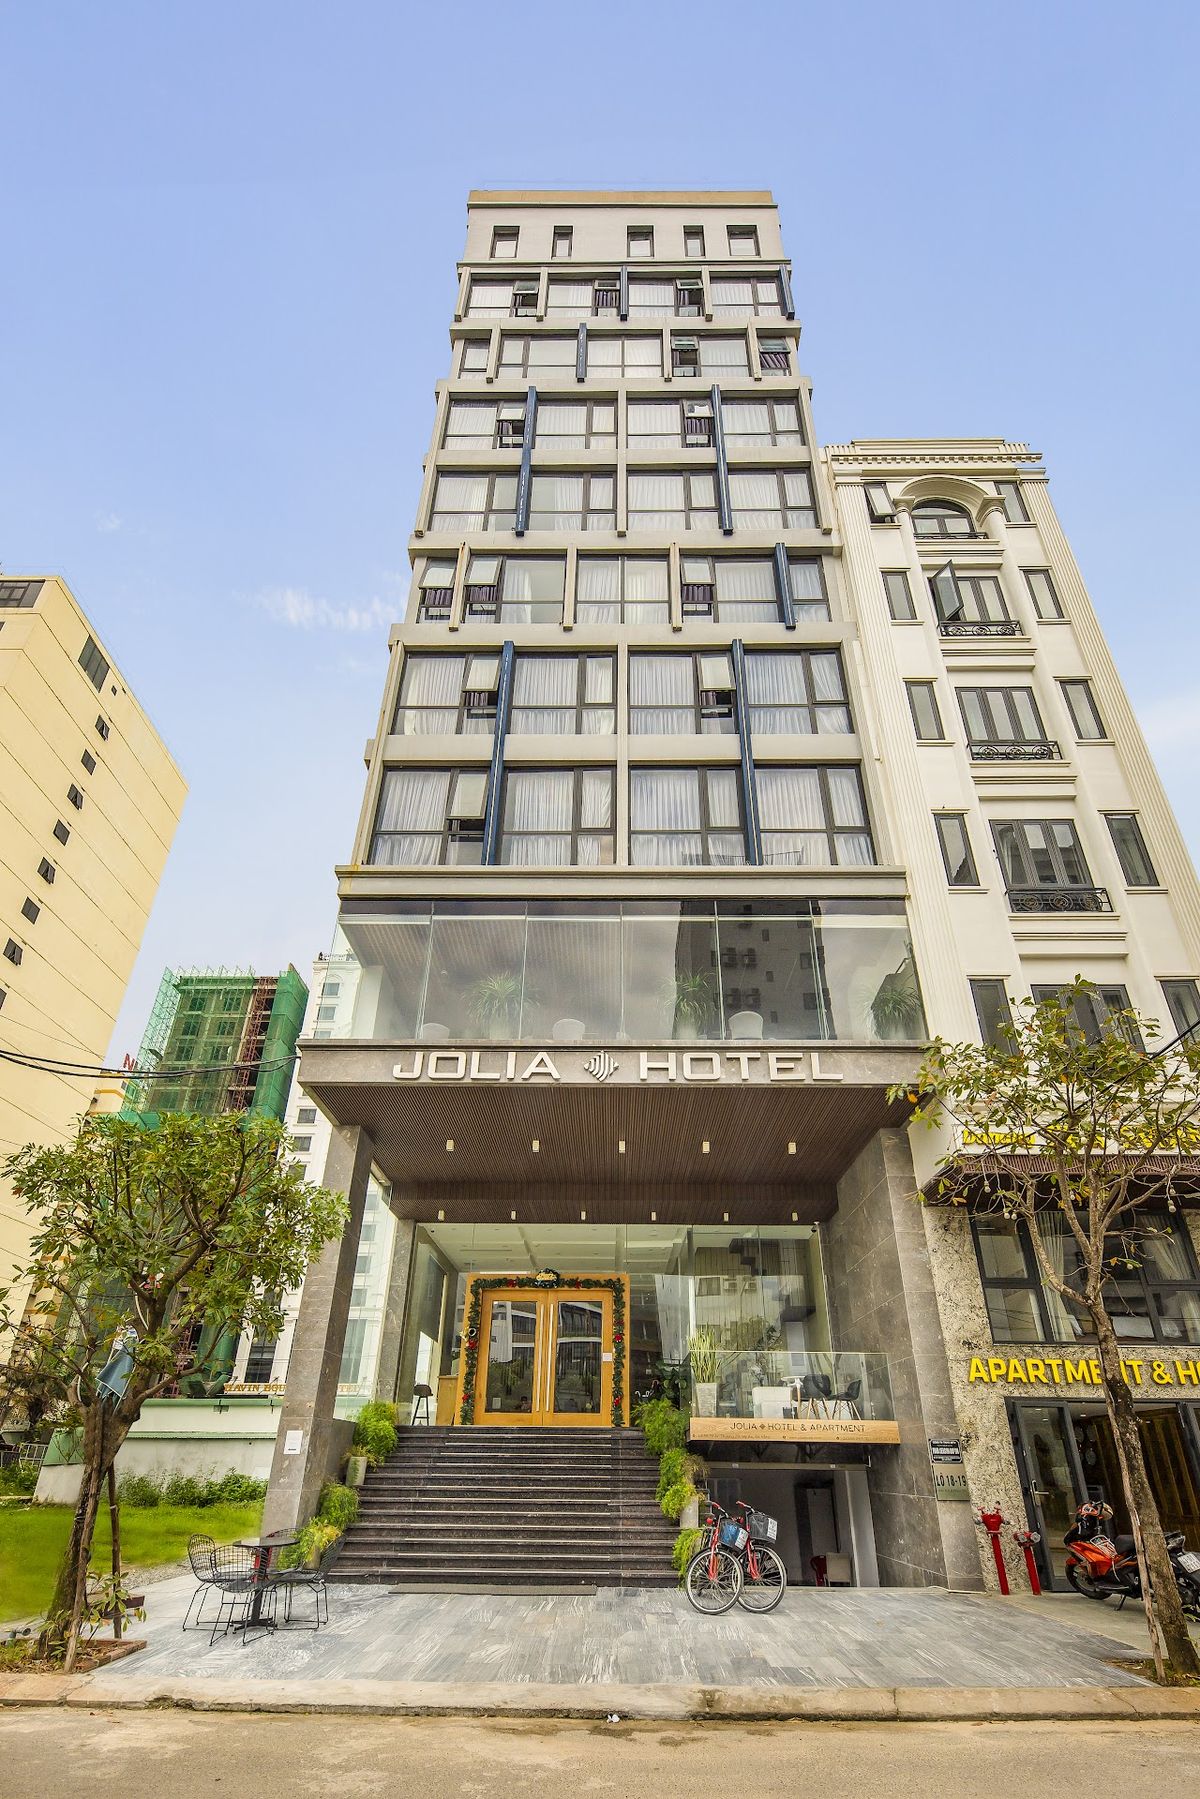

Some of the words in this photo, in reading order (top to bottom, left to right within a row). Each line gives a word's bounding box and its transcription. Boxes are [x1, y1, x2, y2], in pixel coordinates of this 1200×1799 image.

[392, 1051, 563, 1080] JOLIA
[639, 1051, 844, 1081] HOTEL
[1152, 1360, 1174, 1385] &
[1174, 1360, 1200, 1386] H
[730, 1422, 758, 1430] JOLIA
[767, 1423, 798, 1432] HOTEL
[800, 1423, 807, 1432] &
[810, 1424, 866, 1433] APARTMENT
[946, 1475, 967, 1487] 18-19
